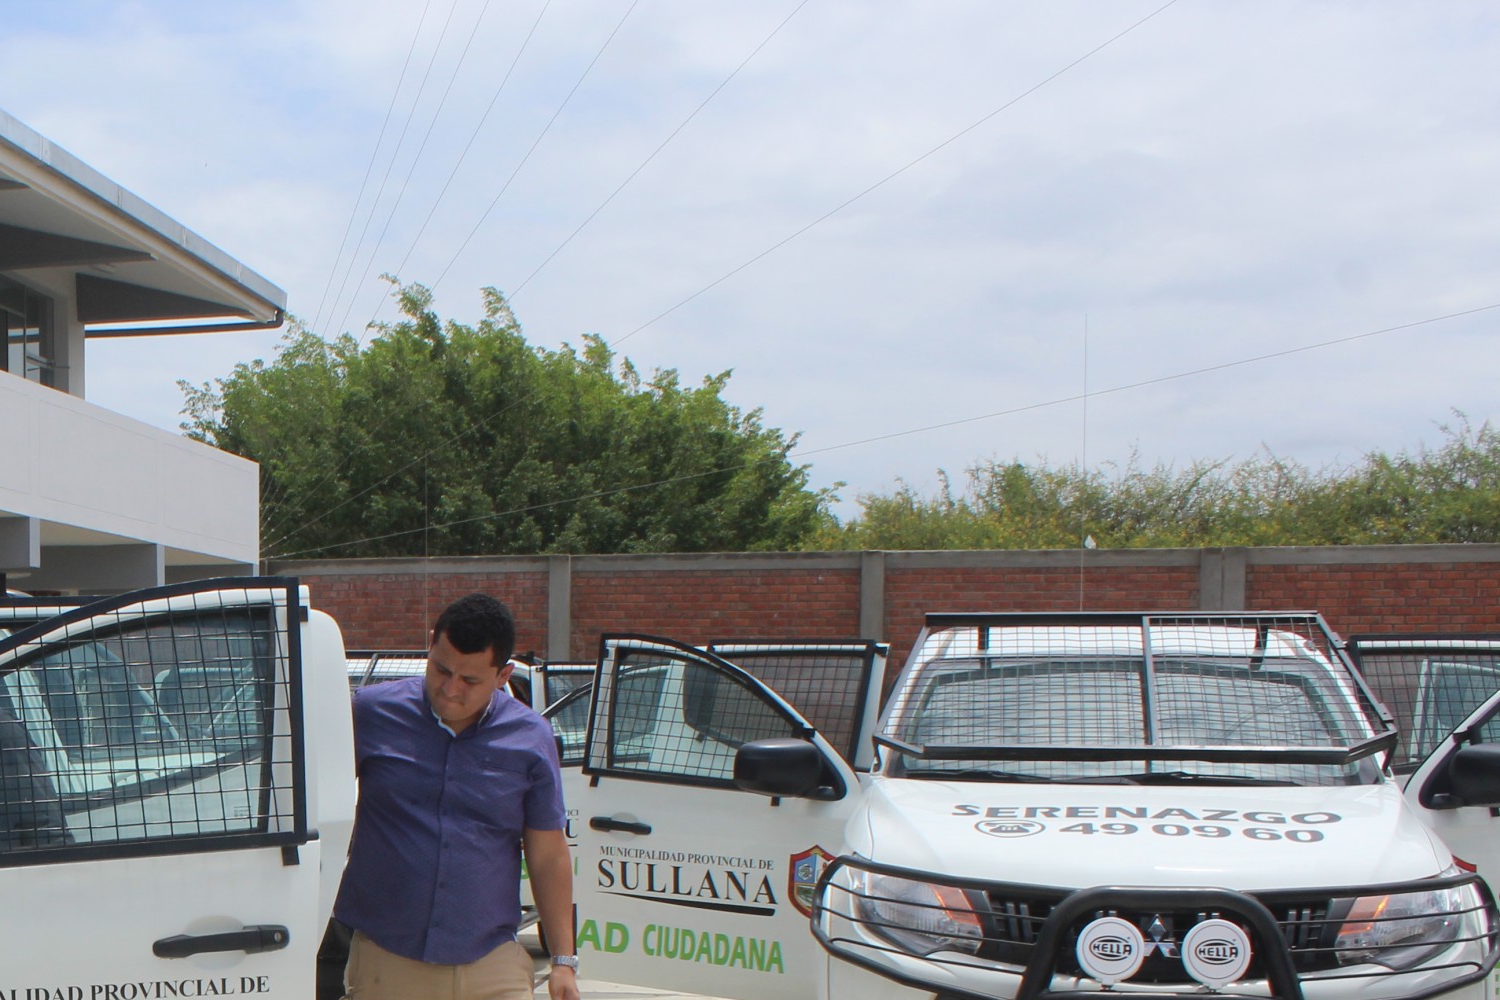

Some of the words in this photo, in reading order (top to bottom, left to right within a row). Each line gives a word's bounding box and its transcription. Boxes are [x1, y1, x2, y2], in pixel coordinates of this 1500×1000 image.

[952, 804, 1342, 824] SERENAZGO
[600, 845, 685, 863] MUNICIPALIDAD
[688, 853, 756, 869] PROVINCIAL
[758, 859, 774, 871] DE
[598, 858, 778, 905] SULLANA
[643, 924, 784, 974] CIUDADANA
[1093, 943, 1132, 956] HELLA
[1198, 946, 1238, 959] HELLA
[239, 976, 271, 994] DE
